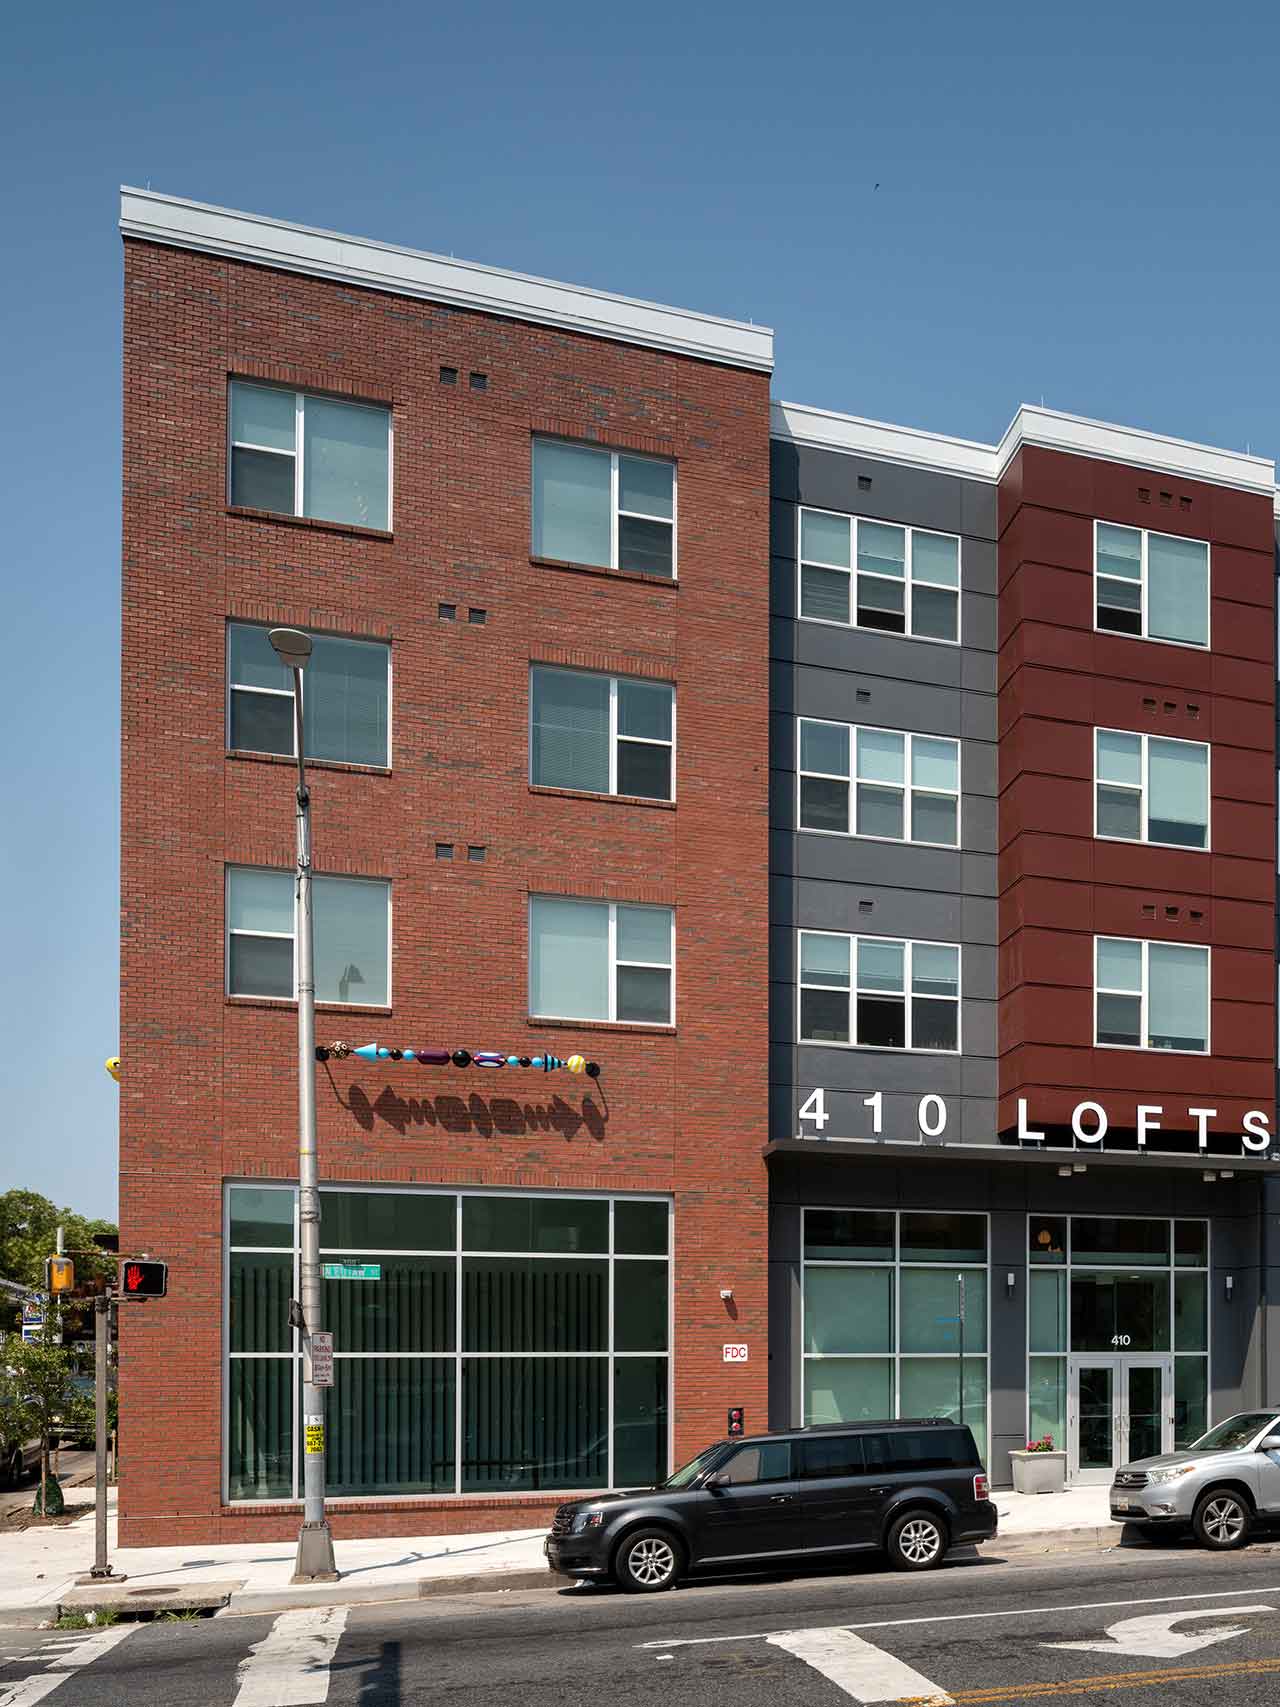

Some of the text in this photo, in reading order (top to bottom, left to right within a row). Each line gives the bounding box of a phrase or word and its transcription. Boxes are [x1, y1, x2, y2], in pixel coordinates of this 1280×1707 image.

[799, 1087, 1270, 1151] 410 LOFTS
[1111, 1334, 1131, 1346] 410
[725, 1347, 746, 1358] FDC
